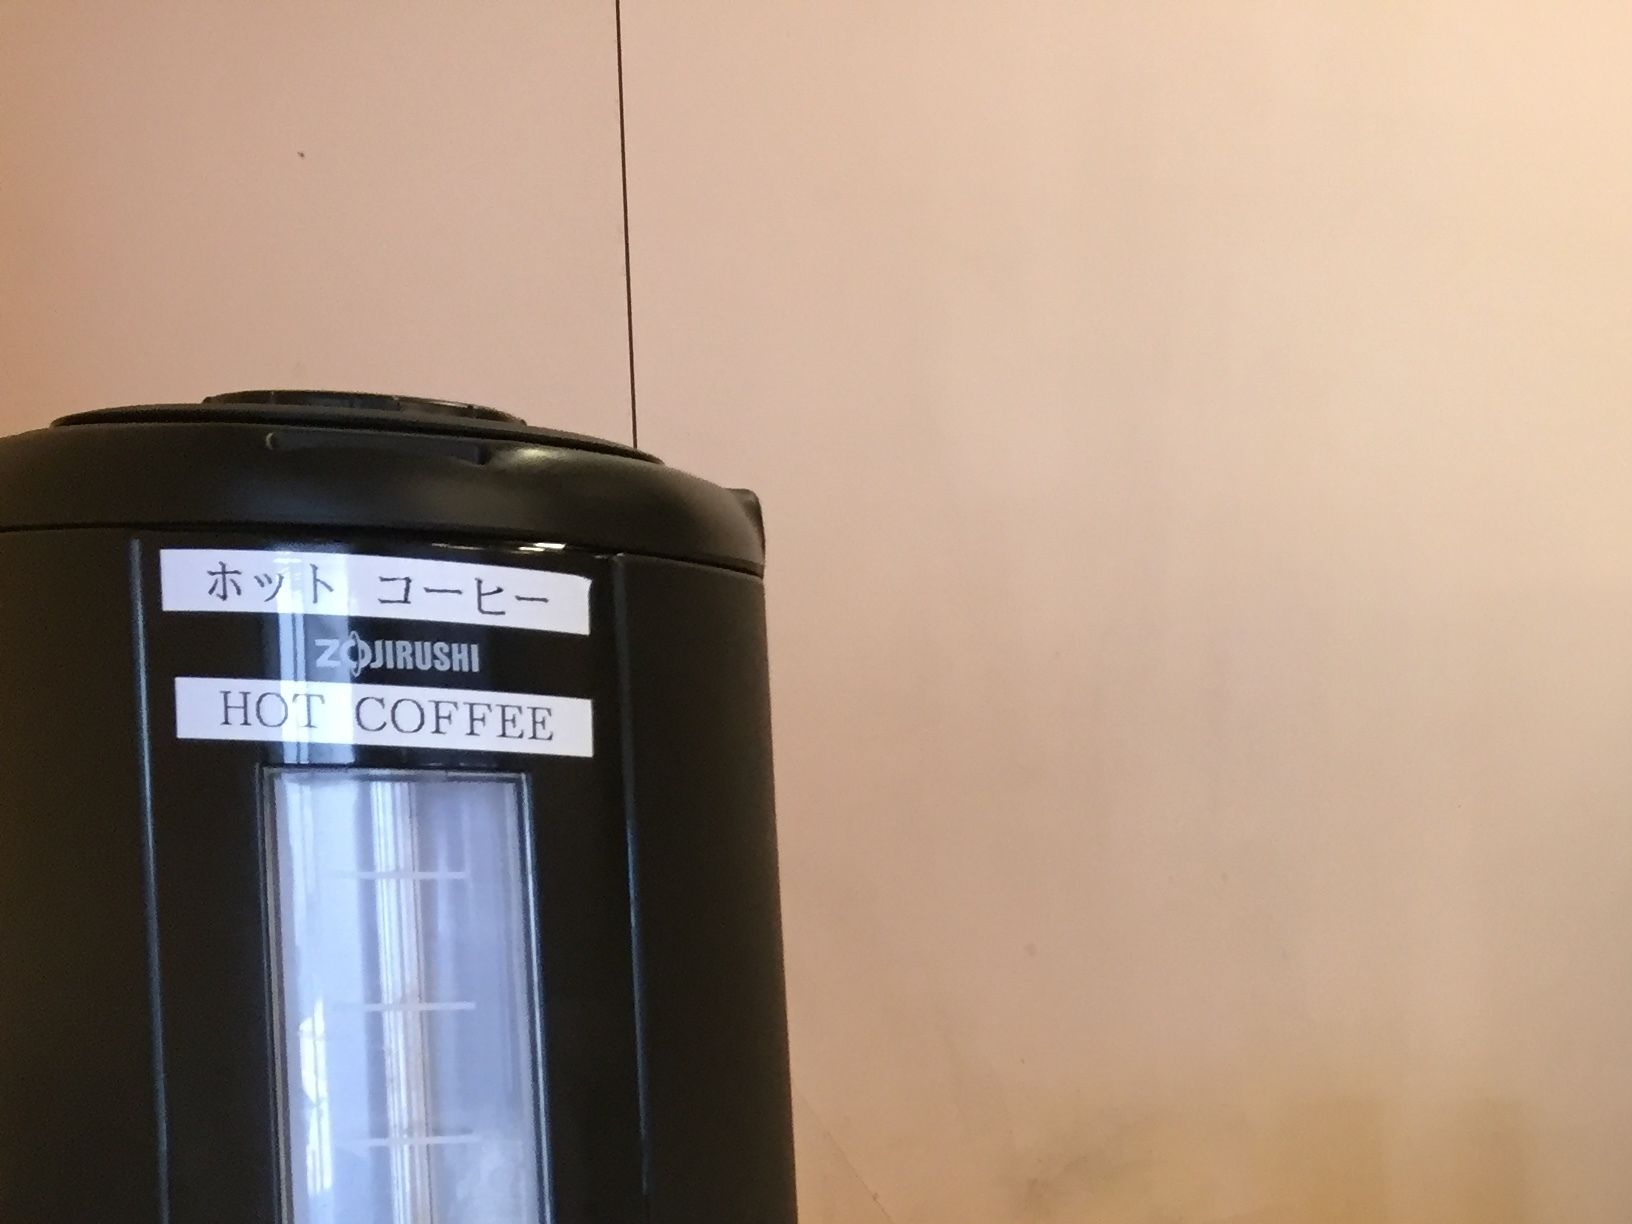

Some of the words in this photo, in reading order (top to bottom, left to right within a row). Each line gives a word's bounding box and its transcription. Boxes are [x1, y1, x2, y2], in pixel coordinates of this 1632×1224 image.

[207, 561, 334, 606] ホット
[376, 572, 550, 618] コーヒー
[314, 630, 480, 678] ZOJIRUSHI
[219, 689, 326, 731] HOT
[355, 695, 555, 744] COFFEE
